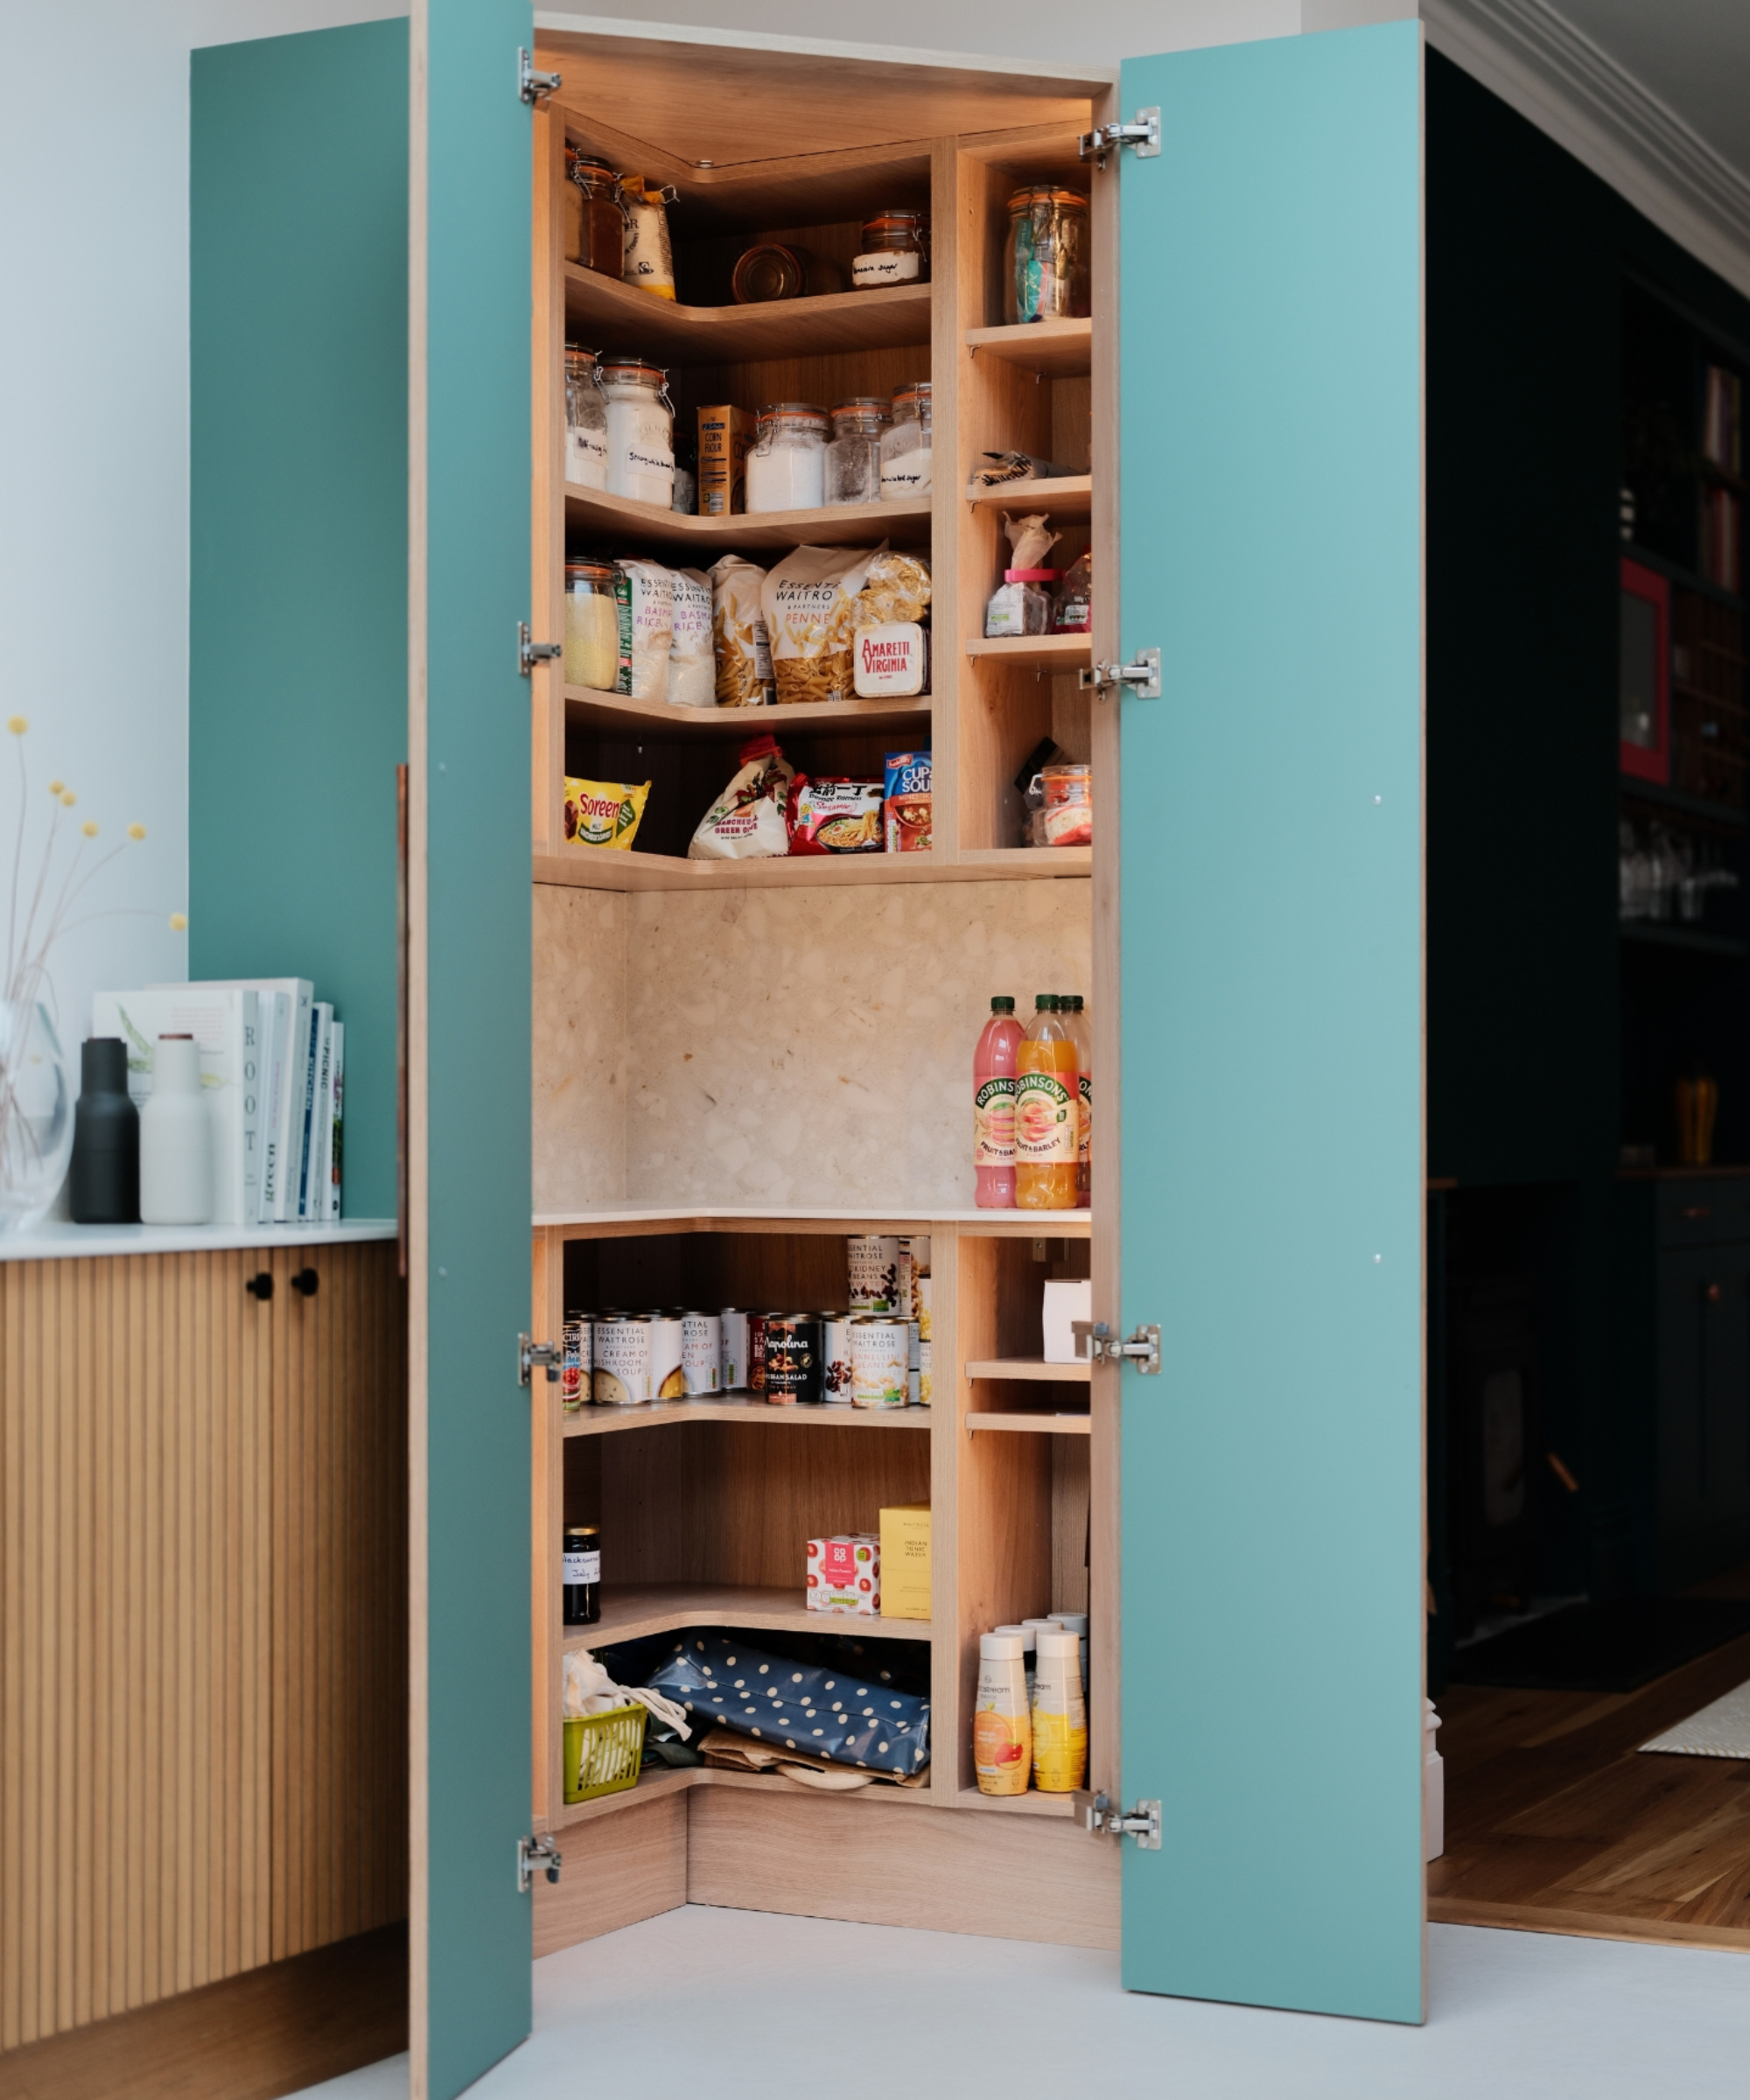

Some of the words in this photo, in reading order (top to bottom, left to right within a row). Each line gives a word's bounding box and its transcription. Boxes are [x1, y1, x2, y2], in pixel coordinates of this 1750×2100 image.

[673, 593, 711, 605] WAITRO
[776, 590, 833, 601] WAITRO
[786, 613, 830, 624] PENNE
[674, 621, 702, 631] RICE
[862, 639, 909, 658] AMARETTI
[864, 655, 907, 674] VIRGINIA
[901, 779, 932, 793] SOU
[580, 793, 620, 819] Soreen
[321, 1046, 331, 1090] PICNIC
[976, 1081, 1015, 1105] ROBINS
[1033, 1138, 1060, 1152] BARLEY
